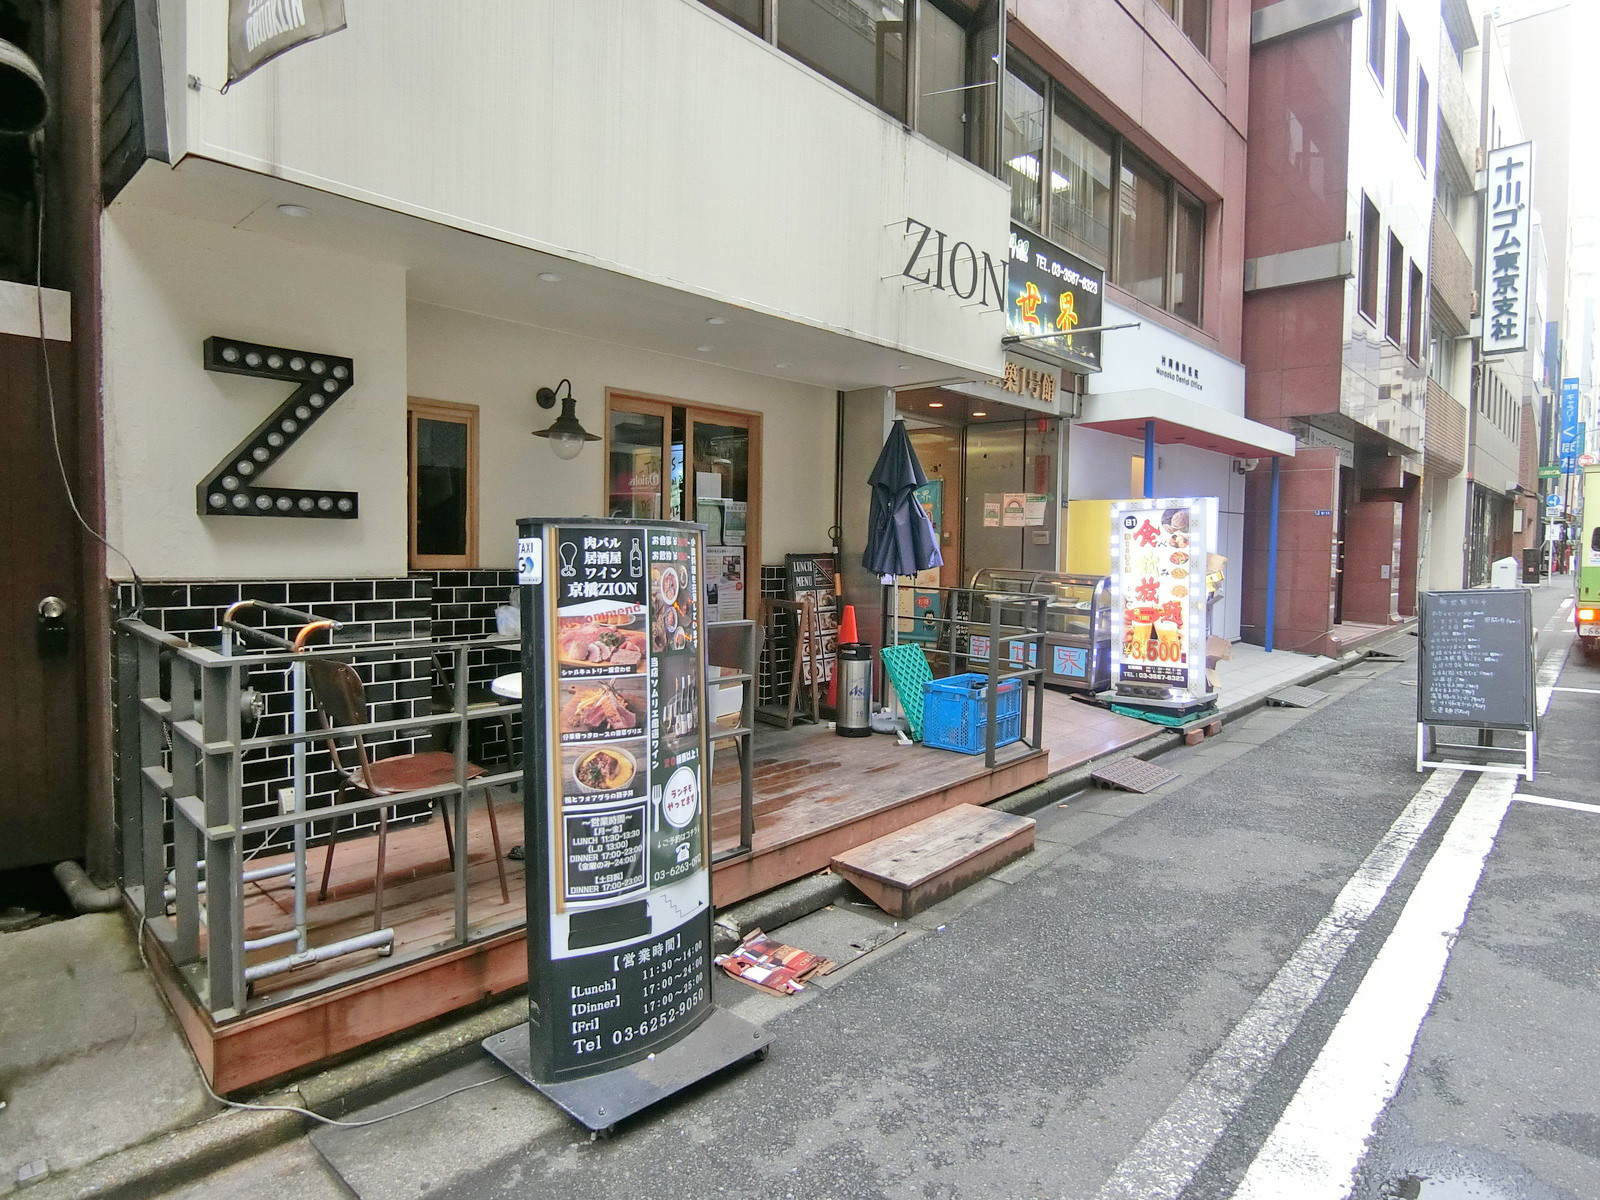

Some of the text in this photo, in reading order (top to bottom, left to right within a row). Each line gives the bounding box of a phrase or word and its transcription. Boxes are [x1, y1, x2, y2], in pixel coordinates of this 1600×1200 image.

[1491, 157, 1525, 341] 十川ゴム東京支社
[903, 217, 1009, 312] ZION
[984, 361, 1057, 402] 築1号館
[1176, 374, 1190, 386] Dental
[1191, 380, 1203, 391] Office
[196, 336, 358, 519] Z
[1126, 519, 1136, 527] B1
[583, 536, 622, 550] 肉バル
[584, 551, 622, 565] 居酒屋
[585, 566, 622, 579] ワイン
[793, 562, 812, 572] LUNCH
[796, 576, 812, 587] MENU
[567, 582, 638, 598] 京橋ZION
[671, 784, 692, 799] ランチも
[667, 794, 695, 812] やってます
[572, 837, 598, 846] LUNCH
[570, 844, 643, 863] DINNER 17:00-23:00
[570, 875, 643, 894] DINNER 17:00-23:00
[573, 987, 704, 1054] Tel 03-6252-9050
